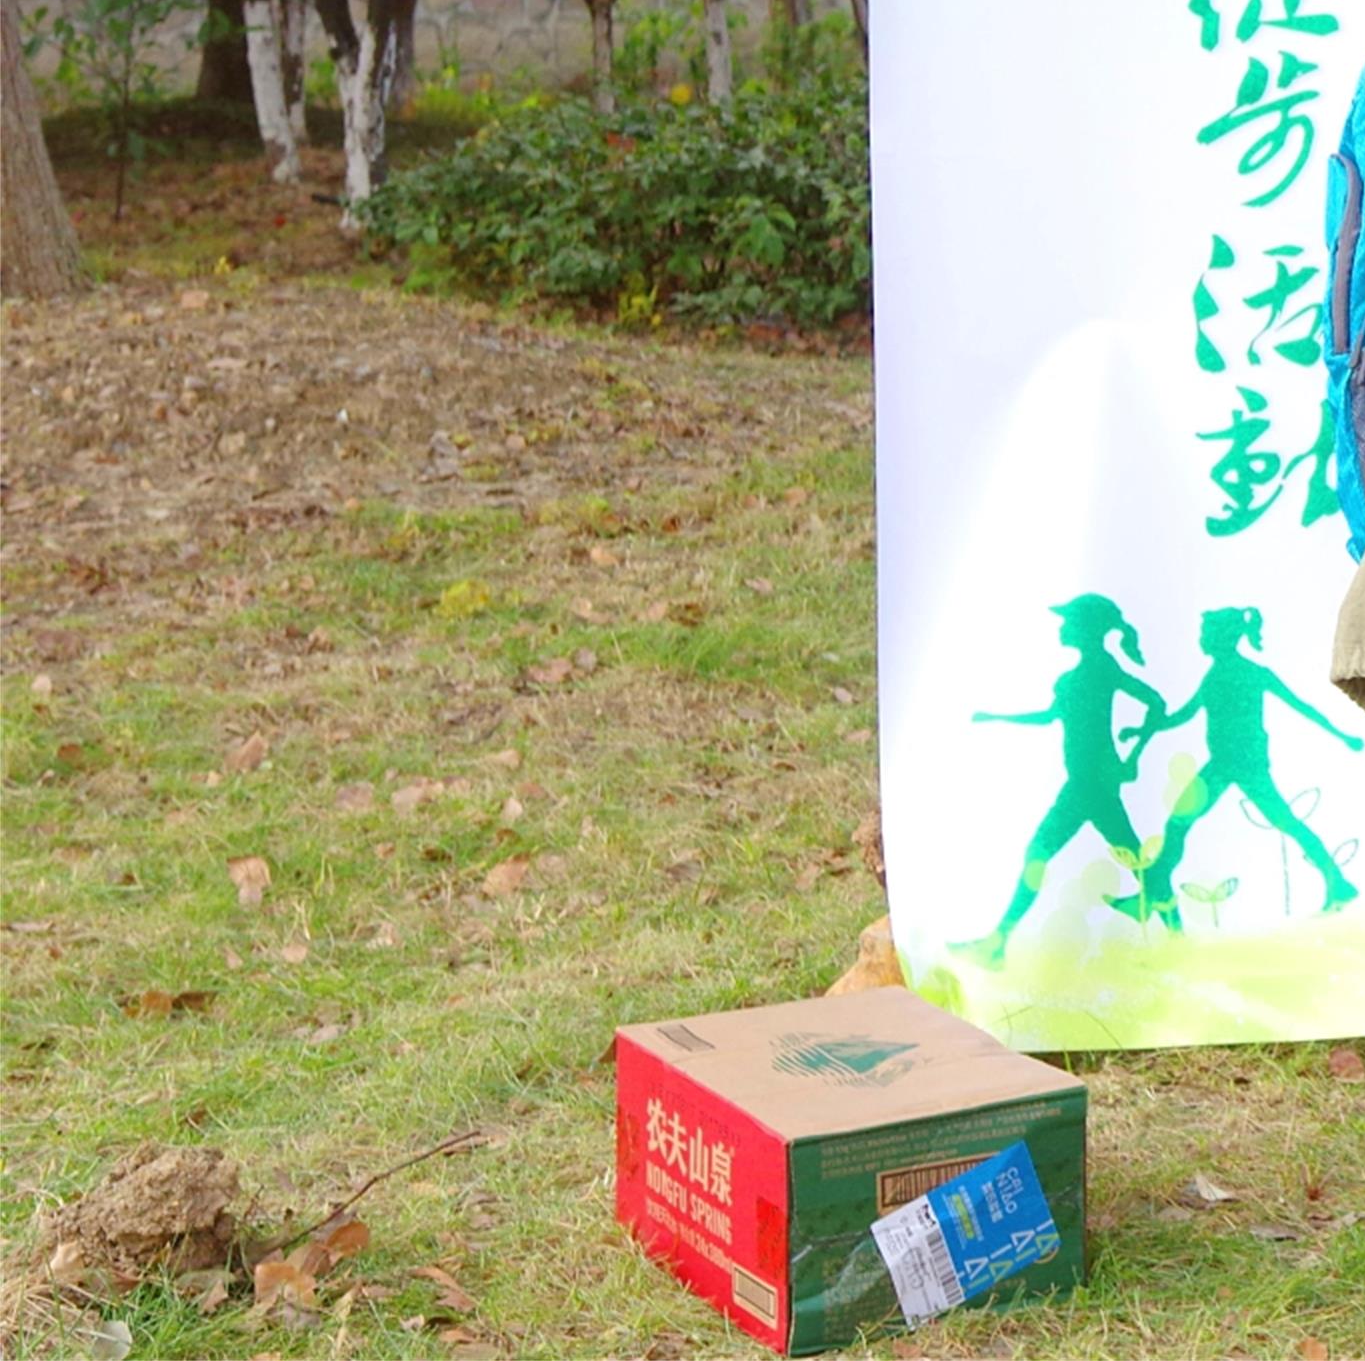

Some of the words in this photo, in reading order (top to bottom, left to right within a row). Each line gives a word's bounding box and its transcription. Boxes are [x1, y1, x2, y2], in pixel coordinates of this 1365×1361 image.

[646, 1097, 733, 1207] 农夫山泉
[645, 1159, 689, 1215] NONGFU
[690, 1192, 733, 1246] SPRING
